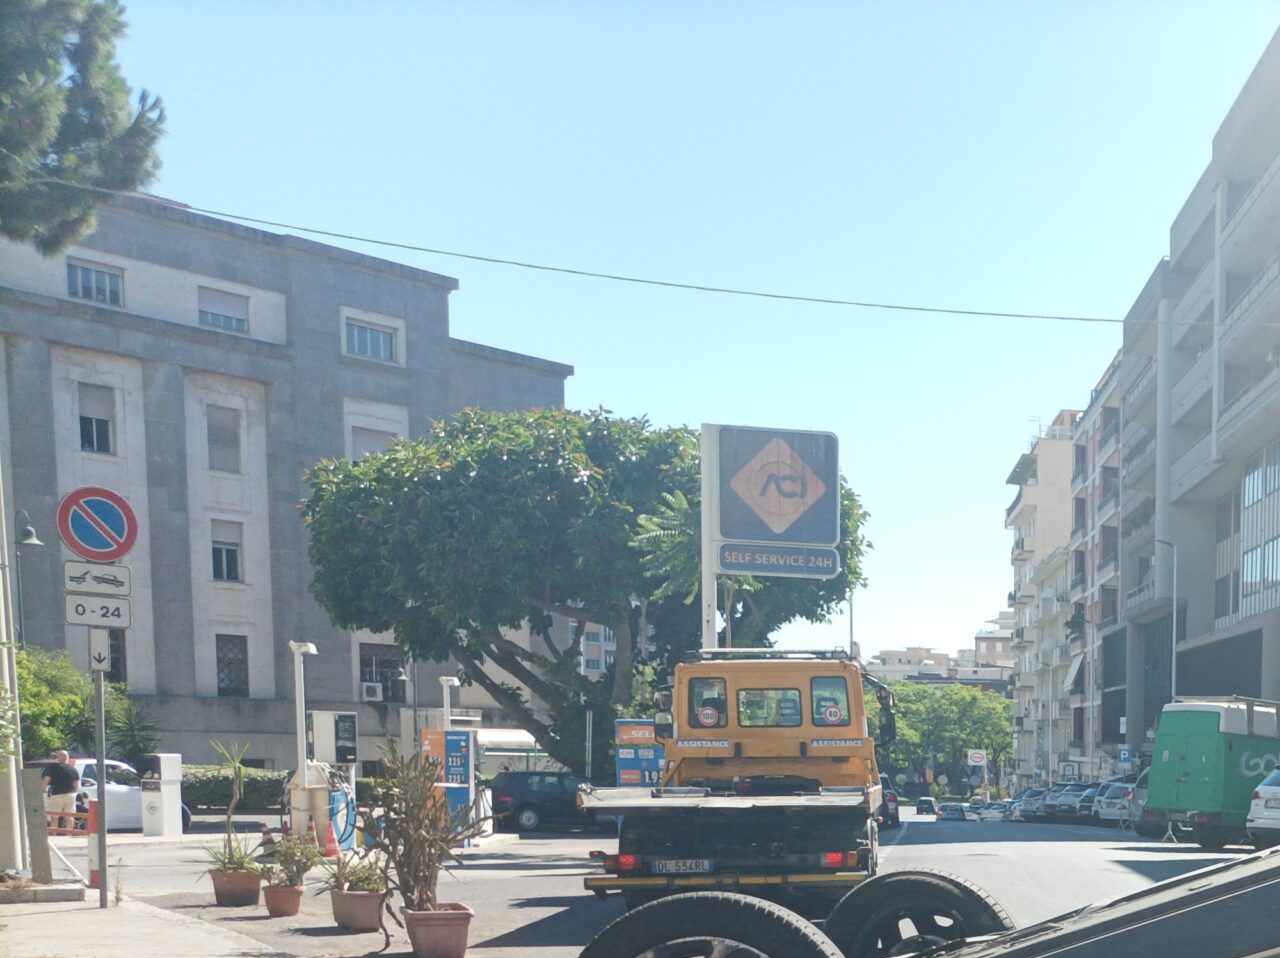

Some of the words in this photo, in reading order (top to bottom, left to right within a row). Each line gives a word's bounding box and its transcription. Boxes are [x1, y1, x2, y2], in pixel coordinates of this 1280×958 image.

[759, 473, 808, 499] ACI
[724, 551, 752, 563] SELF
[754, 553, 805, 566] SERVICE
[809, 556, 833, 568] 24H
[75, 603, 86, 616] 0
[100, 605, 122, 619] 24
[702, 712, 715, 721] 100
[828, 710, 838, 719] 80
[677, 740, 729, 748] ASSISTANCE
[812, 739, 863, 747] ASSISTANCE
[1120, 750, 1129, 761] P
